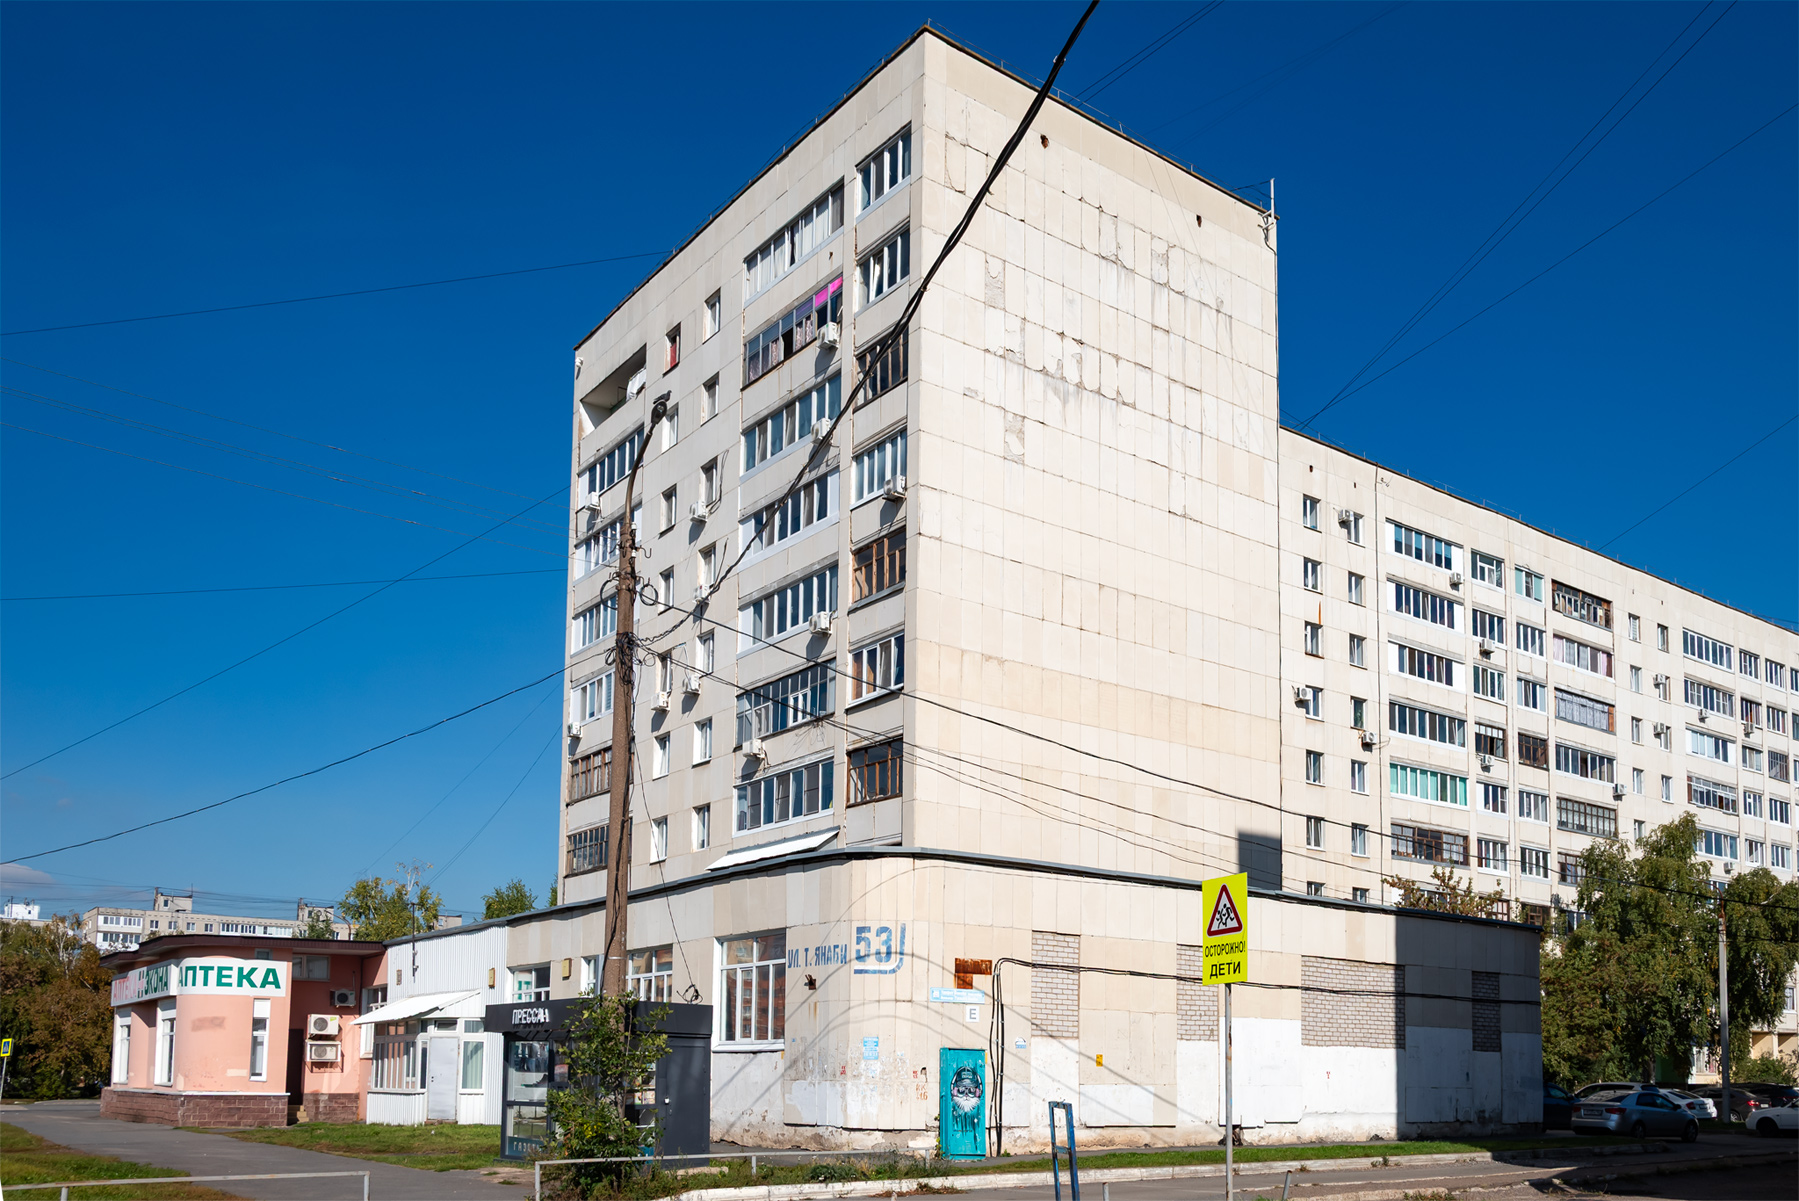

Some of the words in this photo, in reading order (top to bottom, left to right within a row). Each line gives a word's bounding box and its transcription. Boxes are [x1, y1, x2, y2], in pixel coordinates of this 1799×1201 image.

[787, 949, 802, 969] УЛ.
[804, 947, 812, 968] Т.
[814, 944, 848, 966] ЯНАБИ
[855, 926, 893, 963] 53
[1204, 940, 1246, 958] ОСТОРОЖНО!
[178, 966, 282, 989] АПТЕКА
[1209, 961, 1241, 980] ДЕТИ
[113, 974, 137, 1002] АПТЕКА
[145, 966, 169, 995] ЭКОНА
